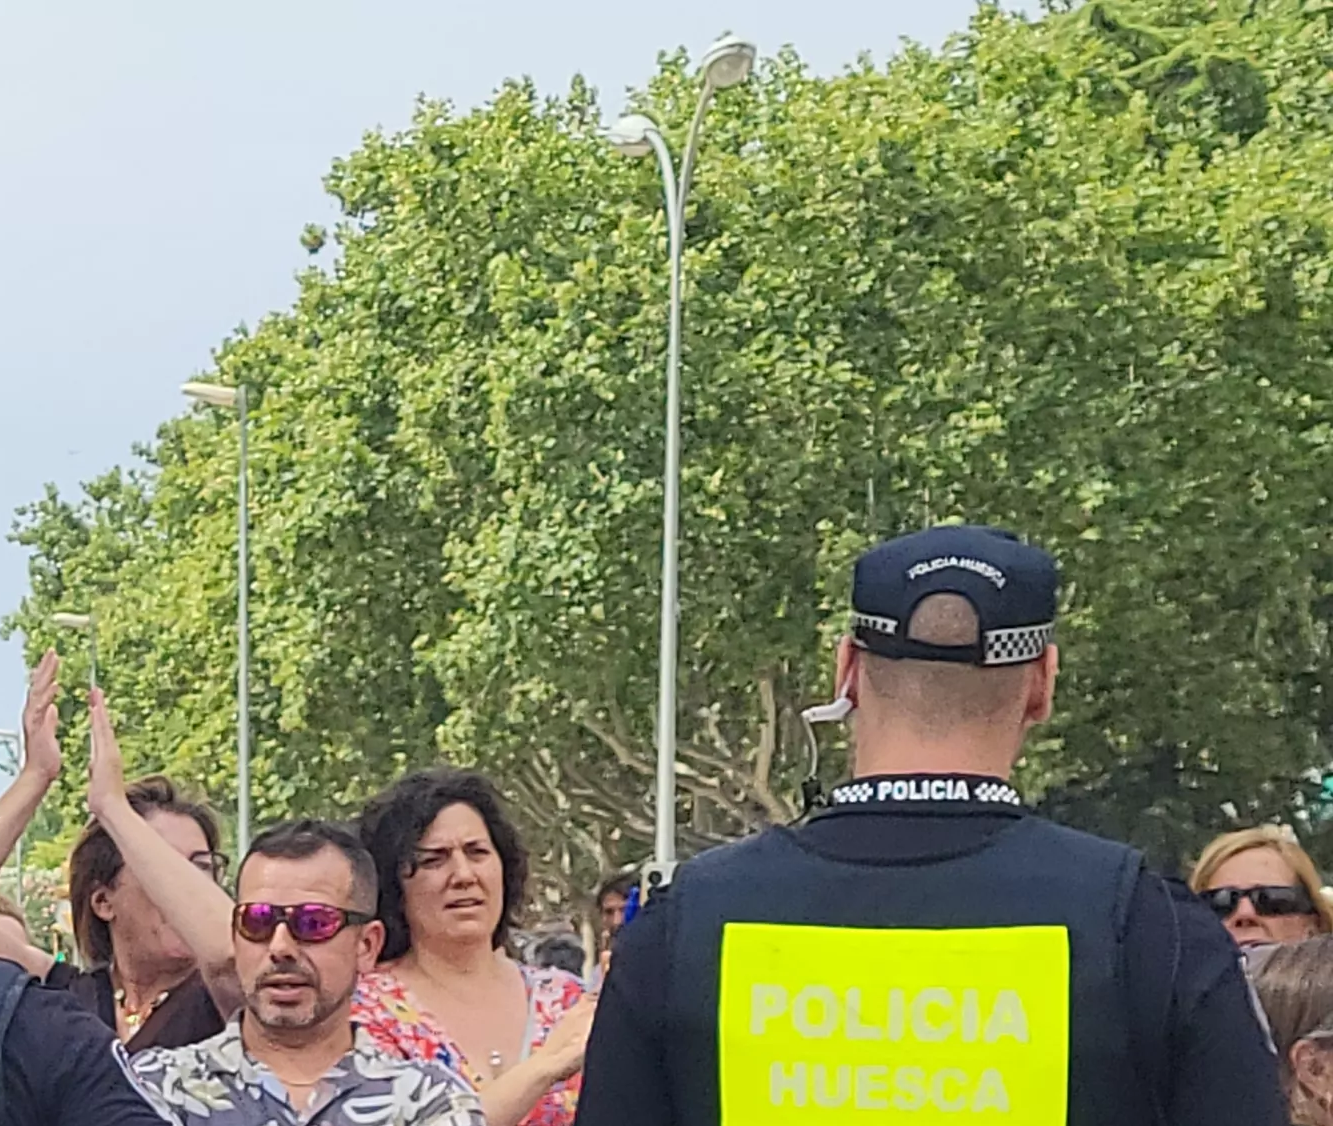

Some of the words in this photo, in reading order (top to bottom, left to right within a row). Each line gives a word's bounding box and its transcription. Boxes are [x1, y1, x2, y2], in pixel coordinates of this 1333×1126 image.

[906, 557, 959, 580] POLICIA
[878, 779, 970, 800] POLICIA
[749, 983, 1030, 1043] POLICIA
[769, 1061, 1011, 1113] HUESCA
